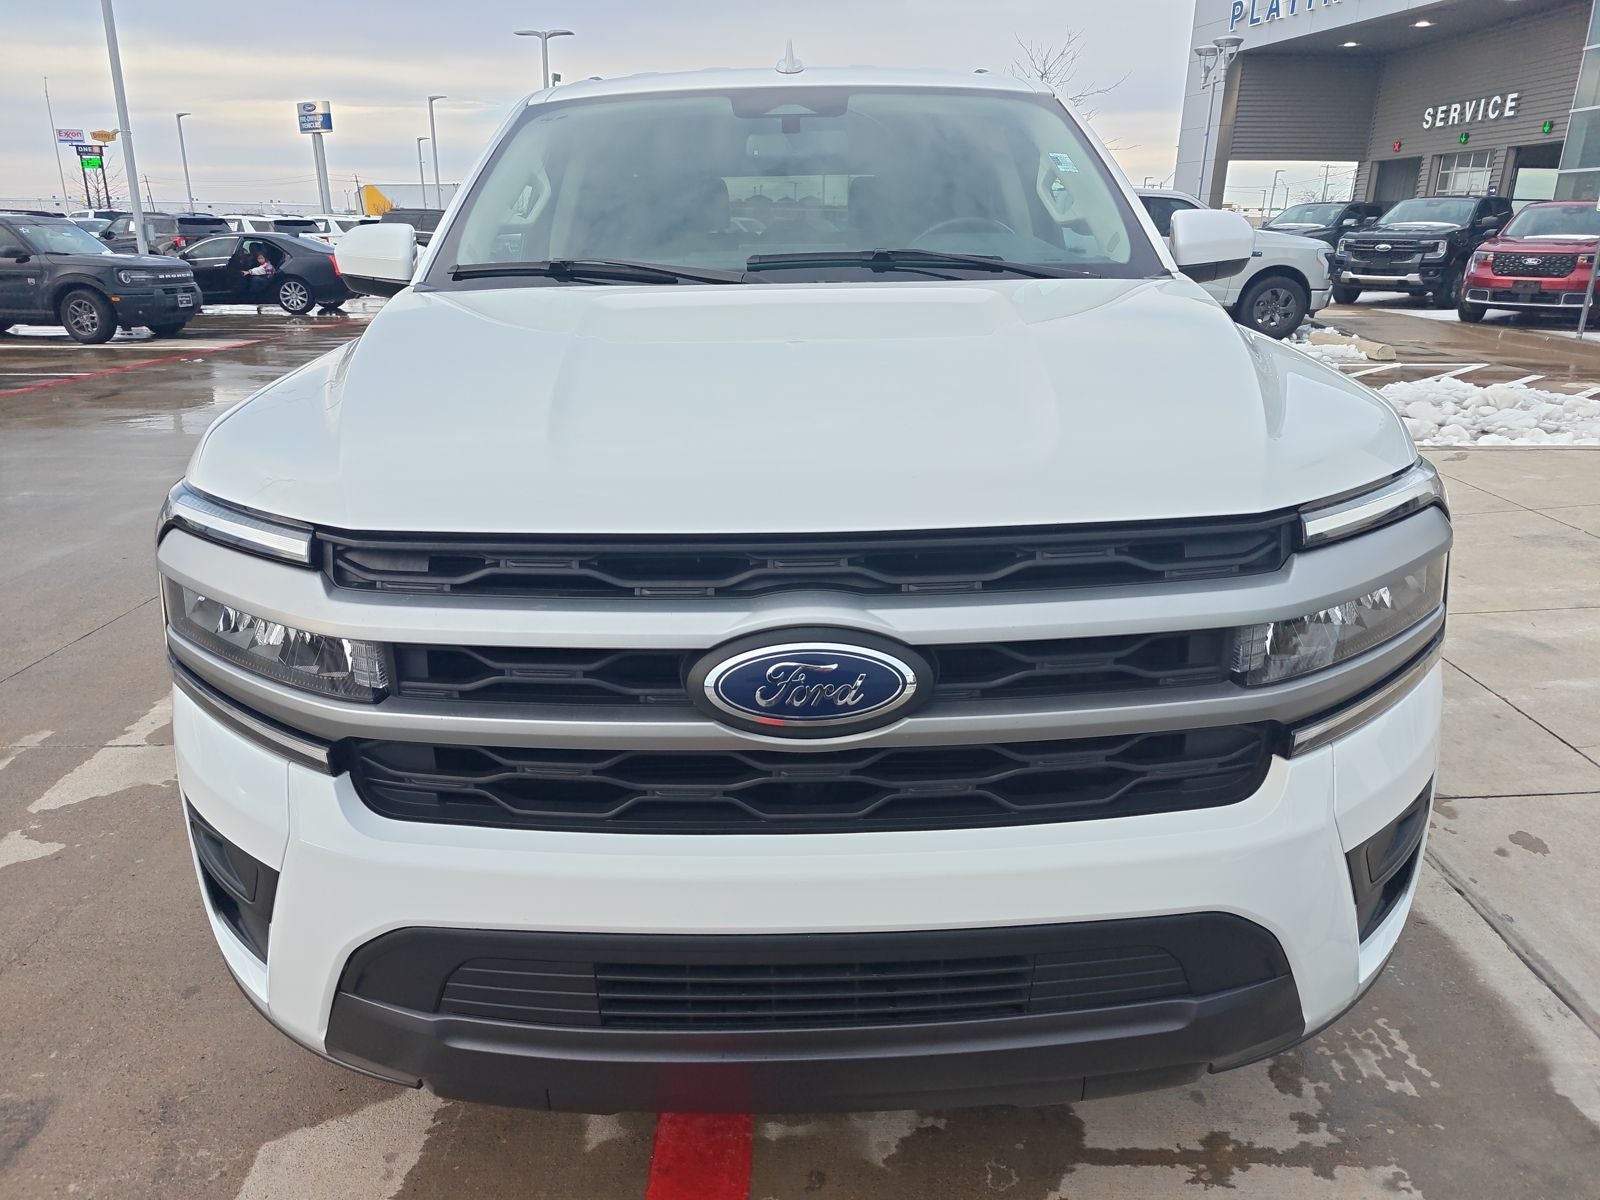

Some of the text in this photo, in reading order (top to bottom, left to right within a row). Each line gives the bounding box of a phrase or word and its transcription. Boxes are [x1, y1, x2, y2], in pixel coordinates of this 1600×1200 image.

[1423, 93, 1519, 129] SERVICE
[58, 130, 82, 139] Exxon
[755, 661, 867, 708] Ford
